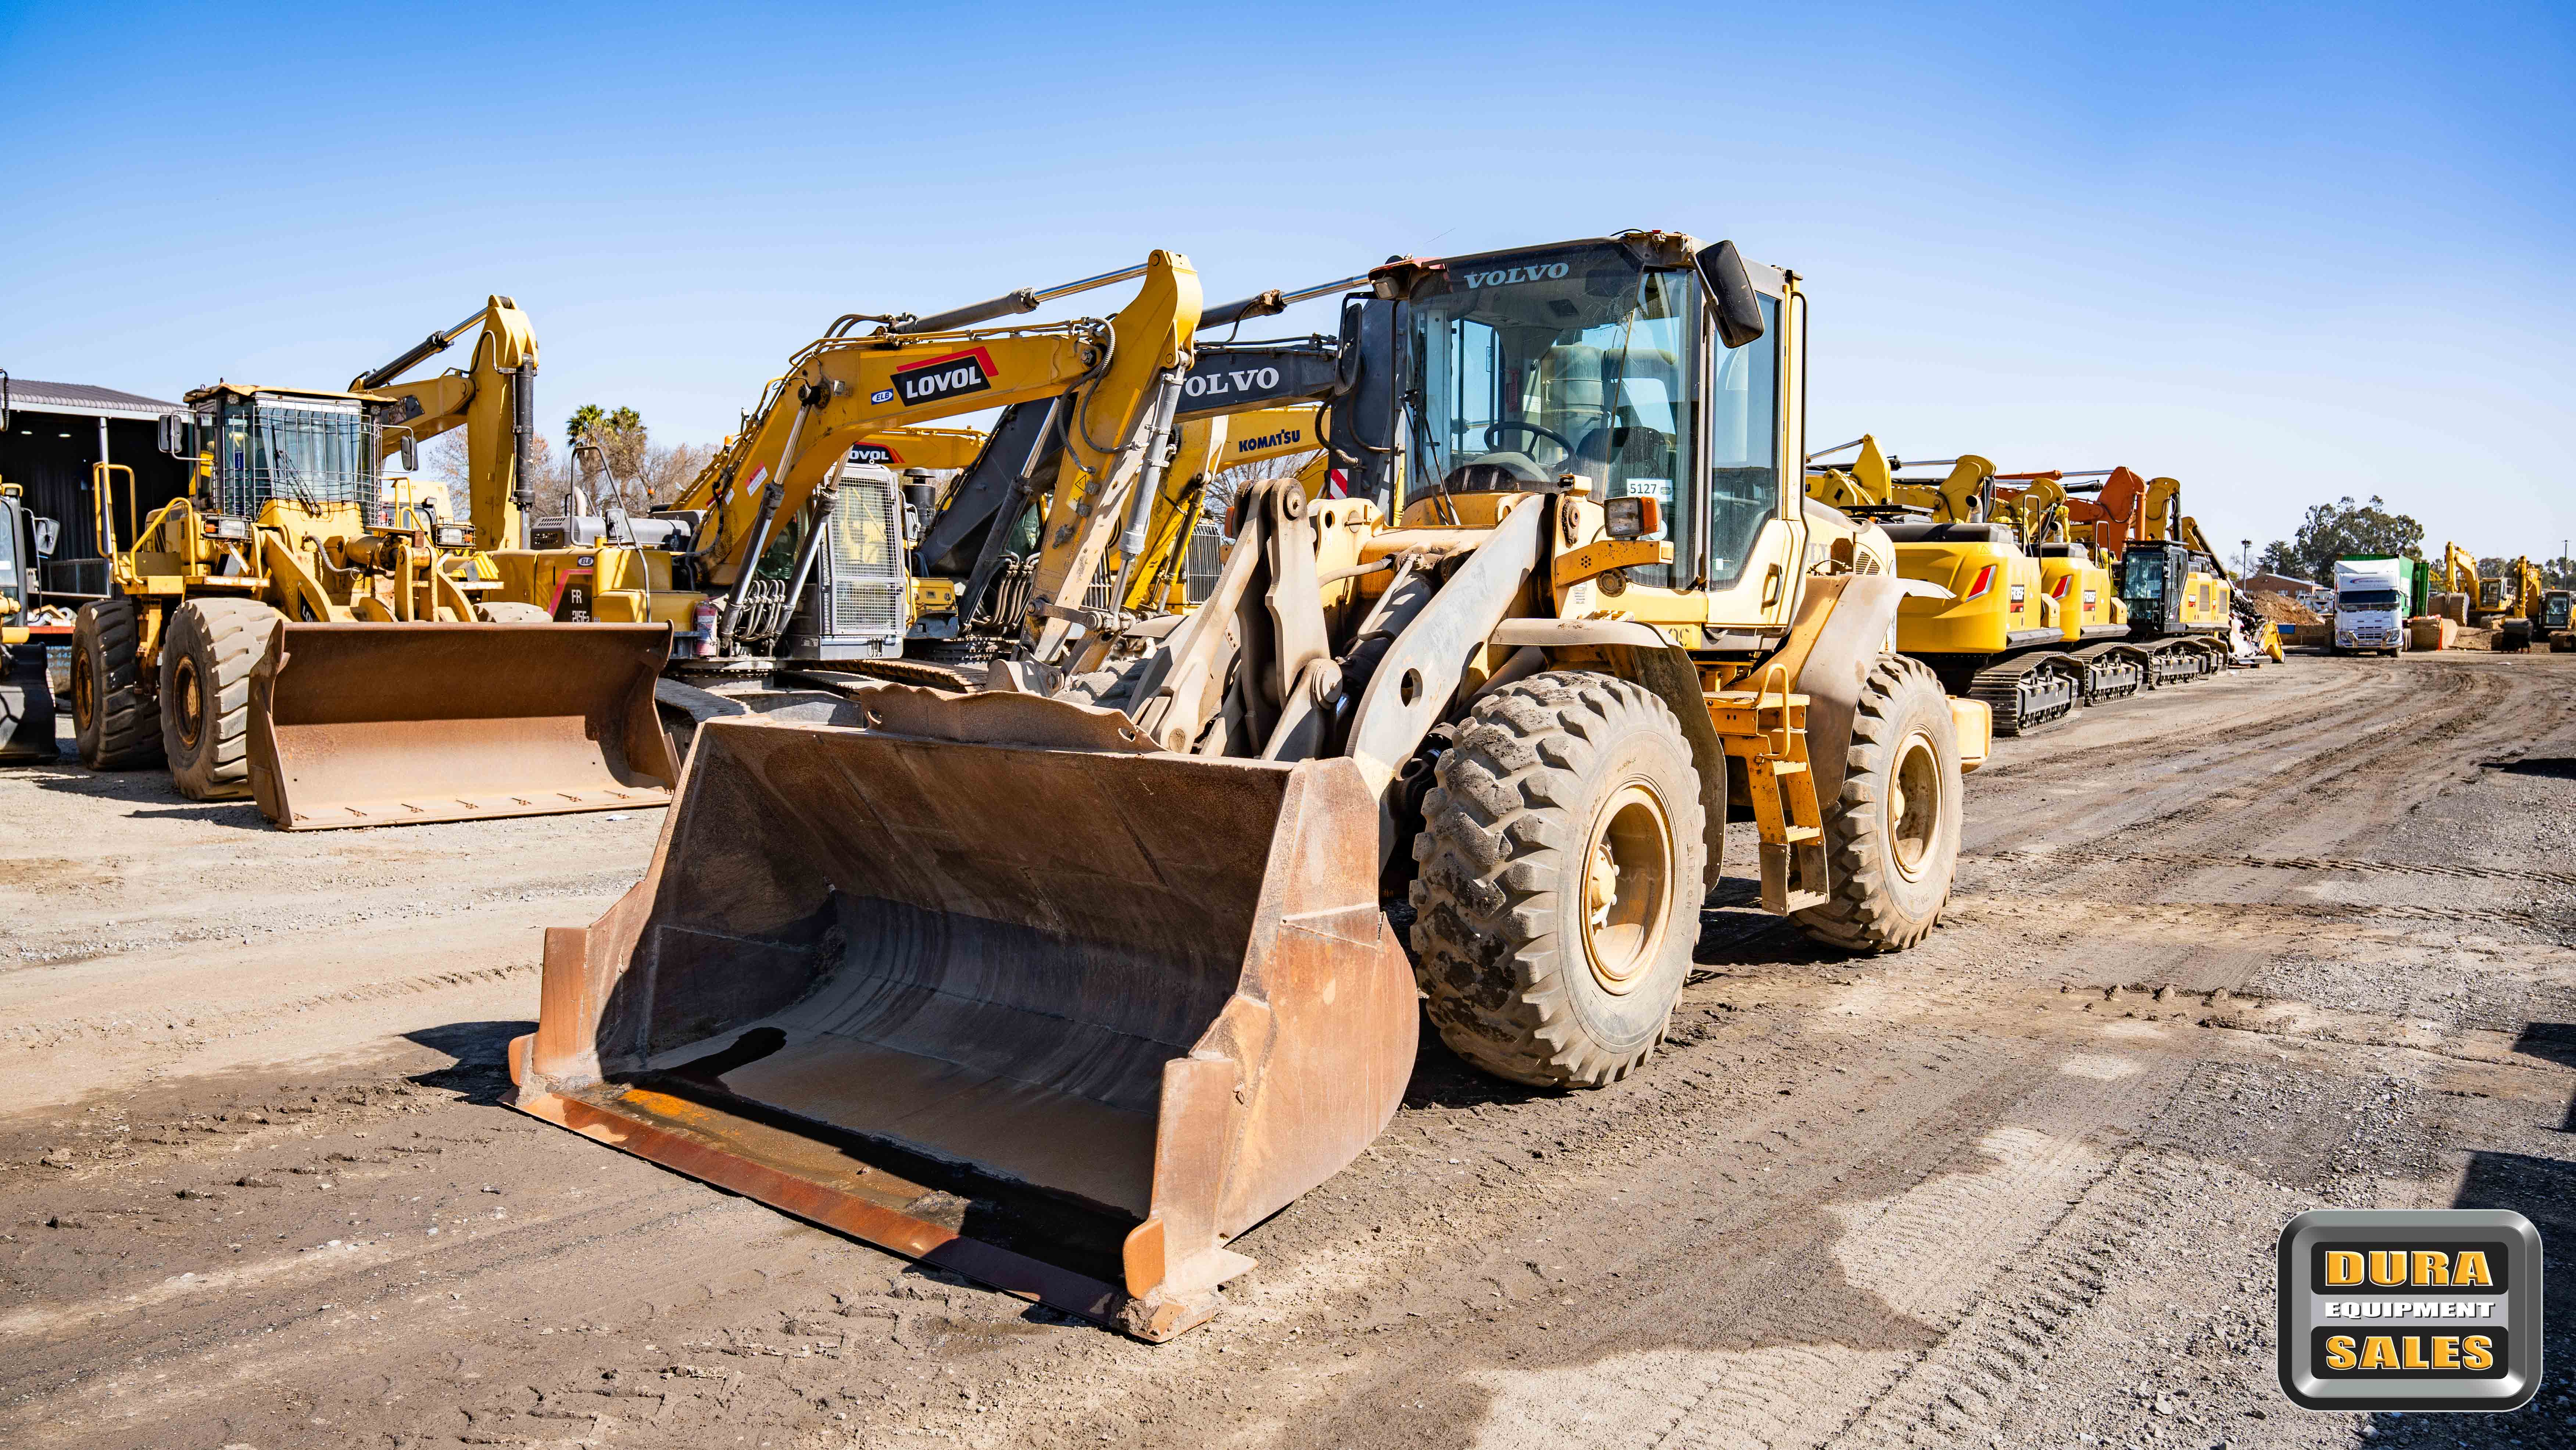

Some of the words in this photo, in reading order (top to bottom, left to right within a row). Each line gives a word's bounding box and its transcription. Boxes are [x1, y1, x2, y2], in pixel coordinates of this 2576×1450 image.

[1464, 262, 1569, 289] VOLVO
[906, 366, 981, 399] LOVOL
[1183, 367, 1279, 397] OLVO
[876, 392, 890, 401] ELB
[1238, 429, 1300, 453] KOMATSU
[848, 450, 889, 460] OVOL
[1630, 483, 1657, 494] 5127
[571, 589, 582, 604] FR
